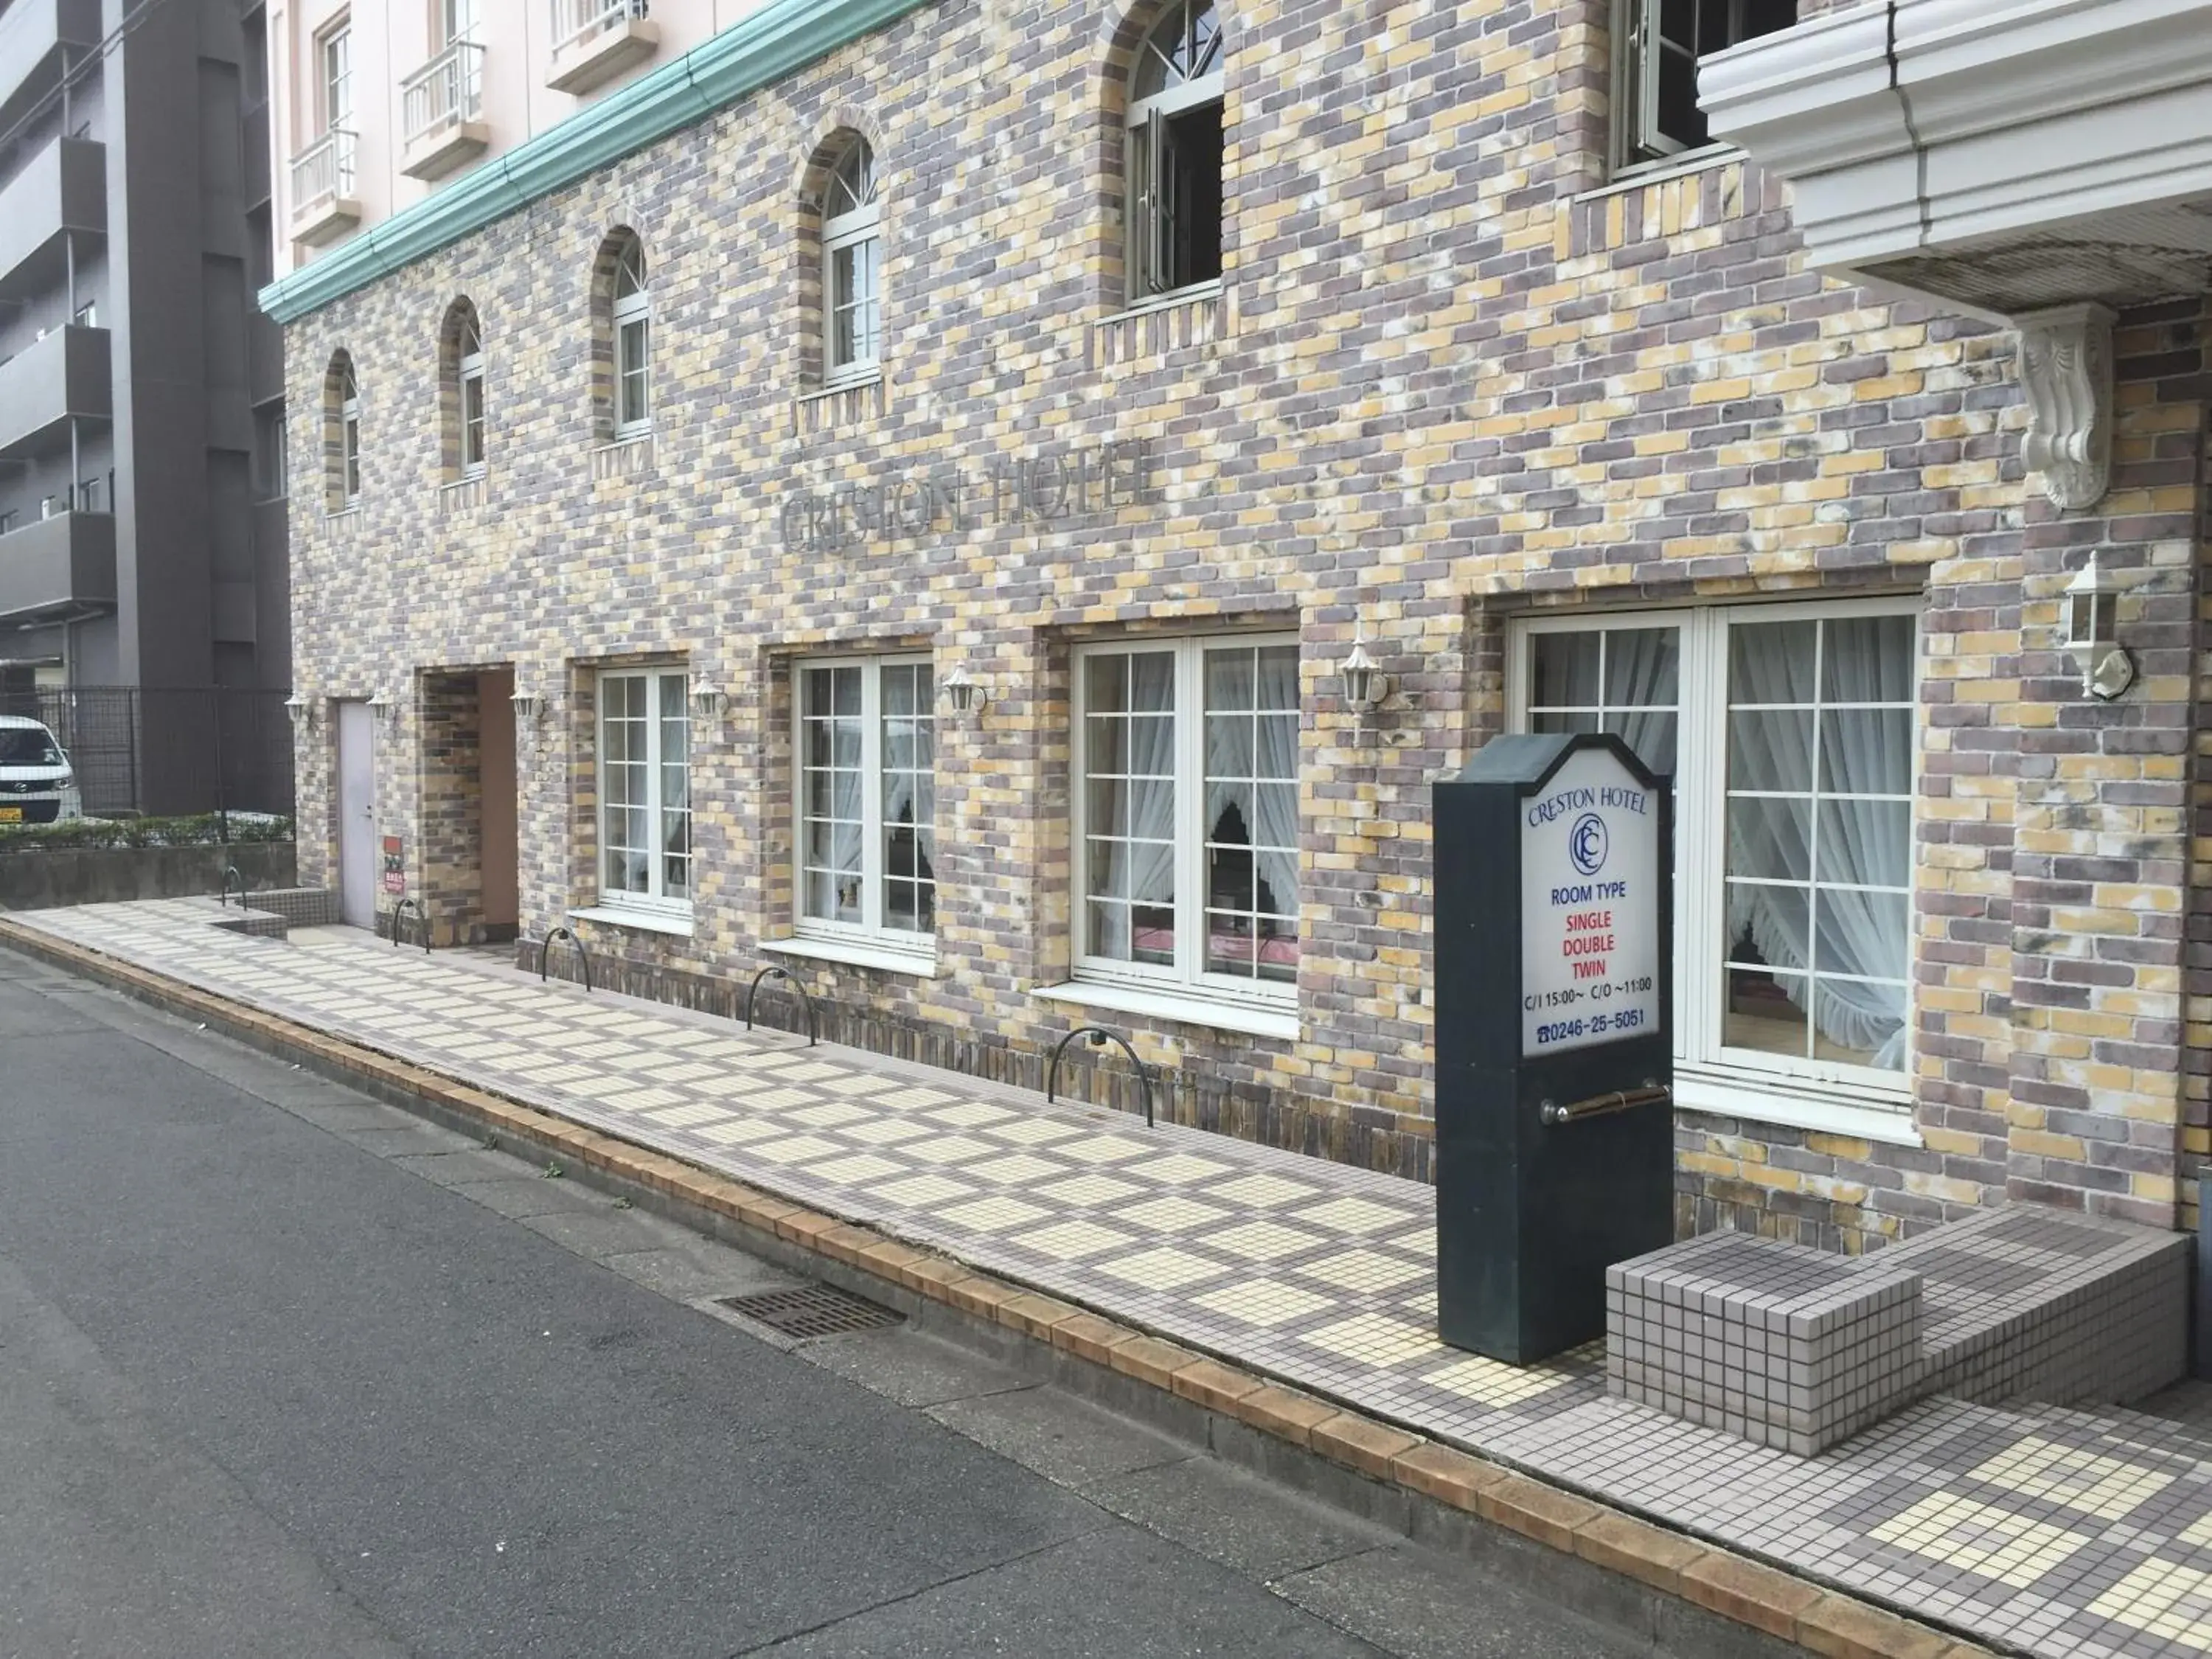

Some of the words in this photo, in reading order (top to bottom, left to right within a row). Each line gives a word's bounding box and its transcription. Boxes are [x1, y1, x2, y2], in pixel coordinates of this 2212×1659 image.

[1528, 787, 1595, 827] CRESTON
[1601, 787, 1646, 815] HOTEL
[1551, 886, 1592, 906] ROOM
[1596, 881, 1626, 900] TYPE
[1566, 911, 1612, 933] SINGLE
[1563, 934, 1615, 957] DOUBLE
[1572, 959, 1606, 980] TWIN
[1590, 983, 1612, 1001] C/O
